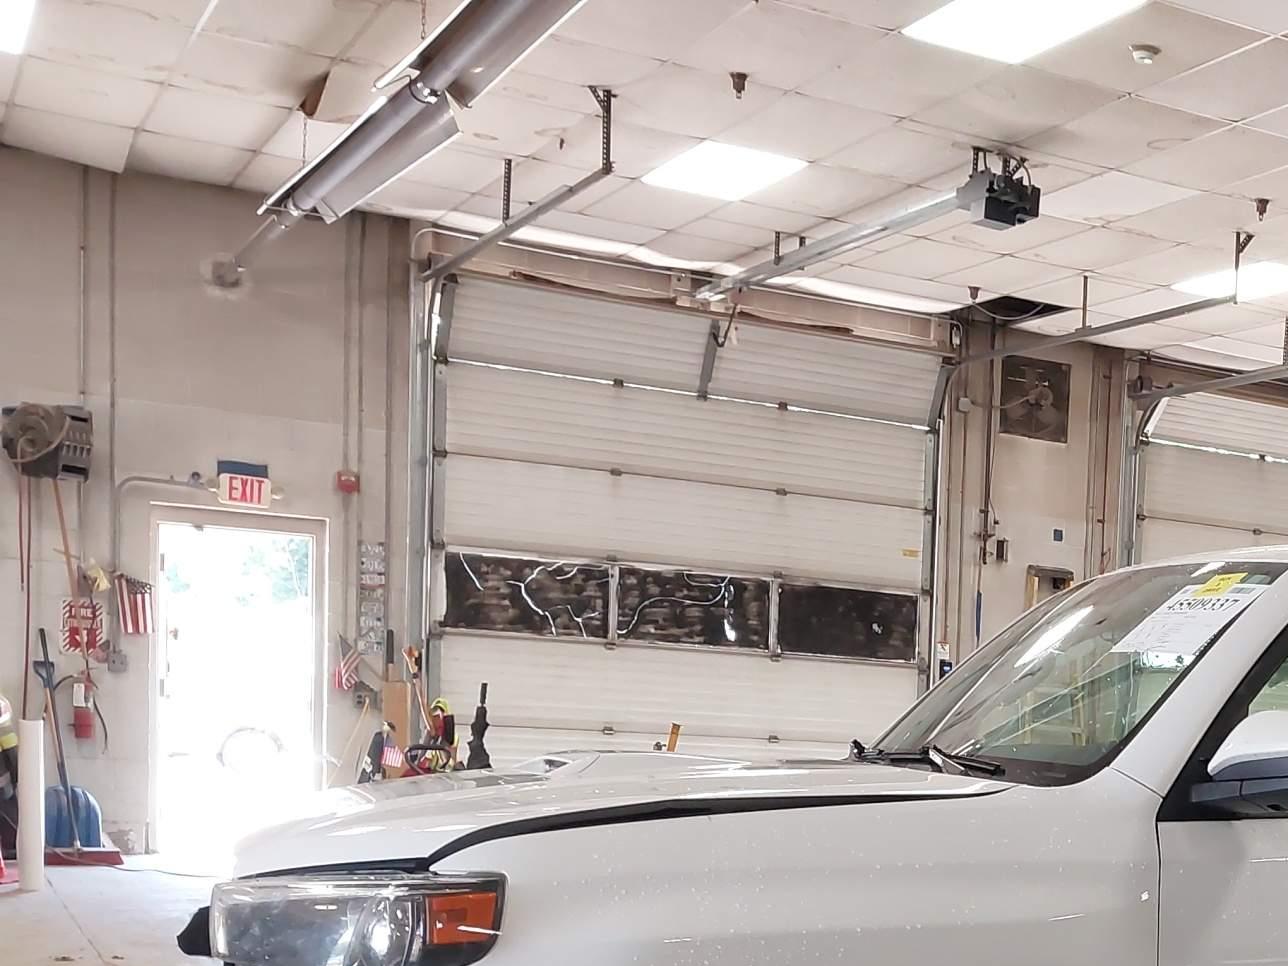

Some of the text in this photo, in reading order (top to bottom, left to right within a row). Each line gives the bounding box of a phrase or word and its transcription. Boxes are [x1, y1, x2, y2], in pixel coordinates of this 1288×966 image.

[228, 476, 265, 504] EXIT
[1166, 597, 1241, 611] 45509337
[71, 607, 94, 617] FRE
